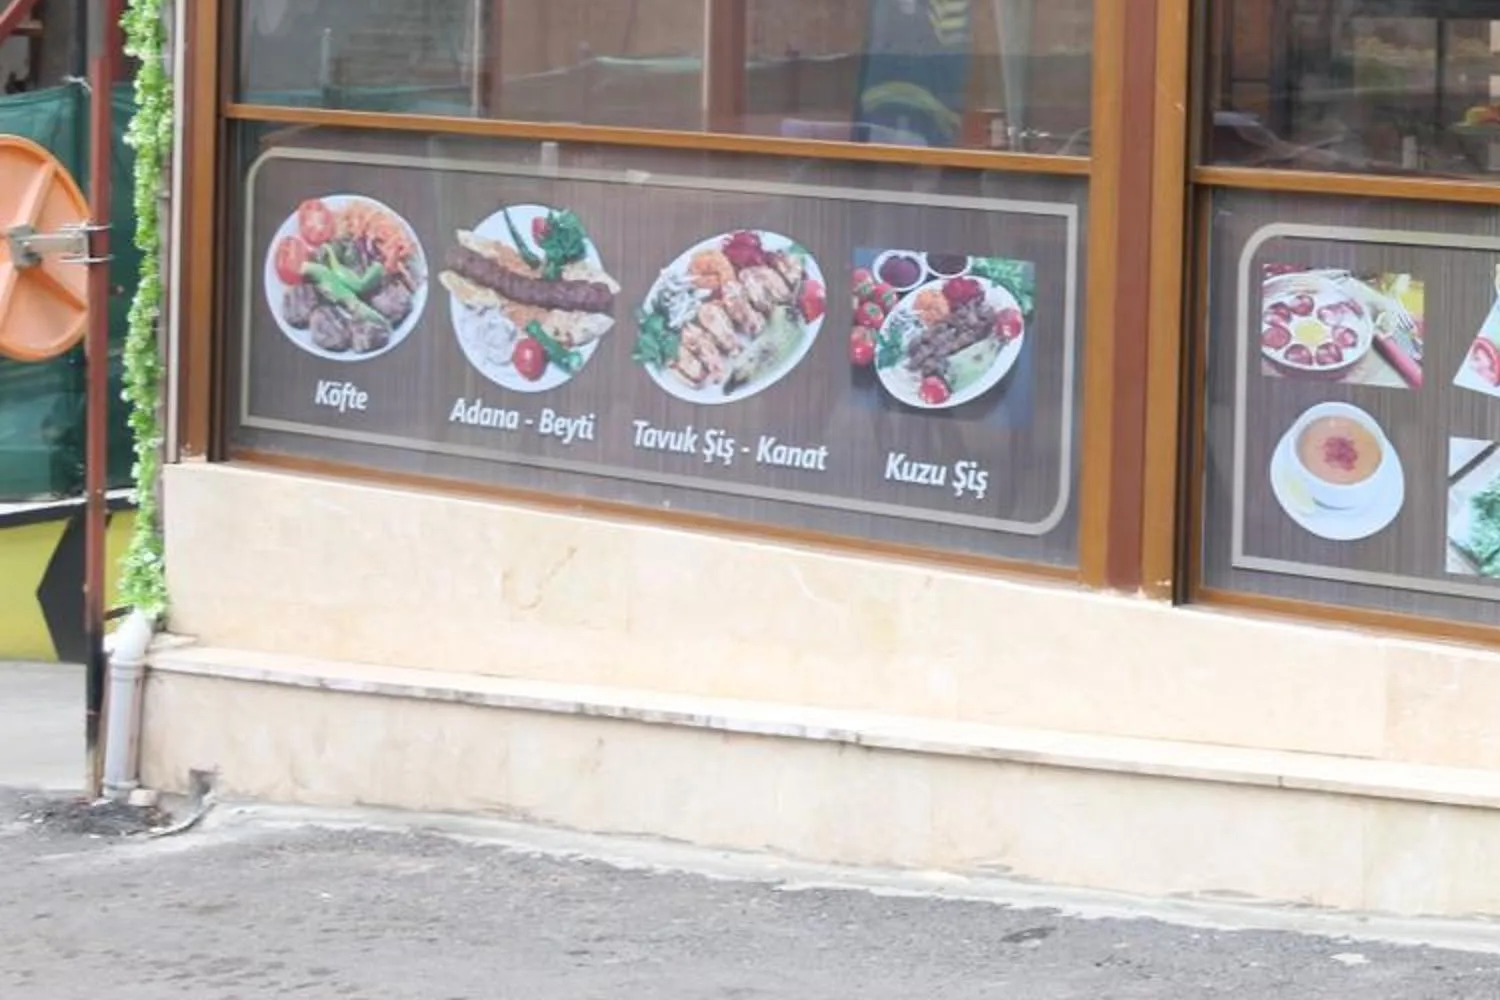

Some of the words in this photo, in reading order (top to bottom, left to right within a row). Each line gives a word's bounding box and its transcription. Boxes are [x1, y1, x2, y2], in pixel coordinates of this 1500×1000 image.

[314, 379, 369, 413] Köfte
[449, 397, 519, 431] Adana
[538, 408, 597, 445] Beyti
[632, 419, 698, 454] Tavuk
[702, 429, 736, 467] Şiş
[755, 435, 829, 472] Kanat
[884, 452, 947, 486] Kuzu
[952, 461, 989, 499] Şiş
